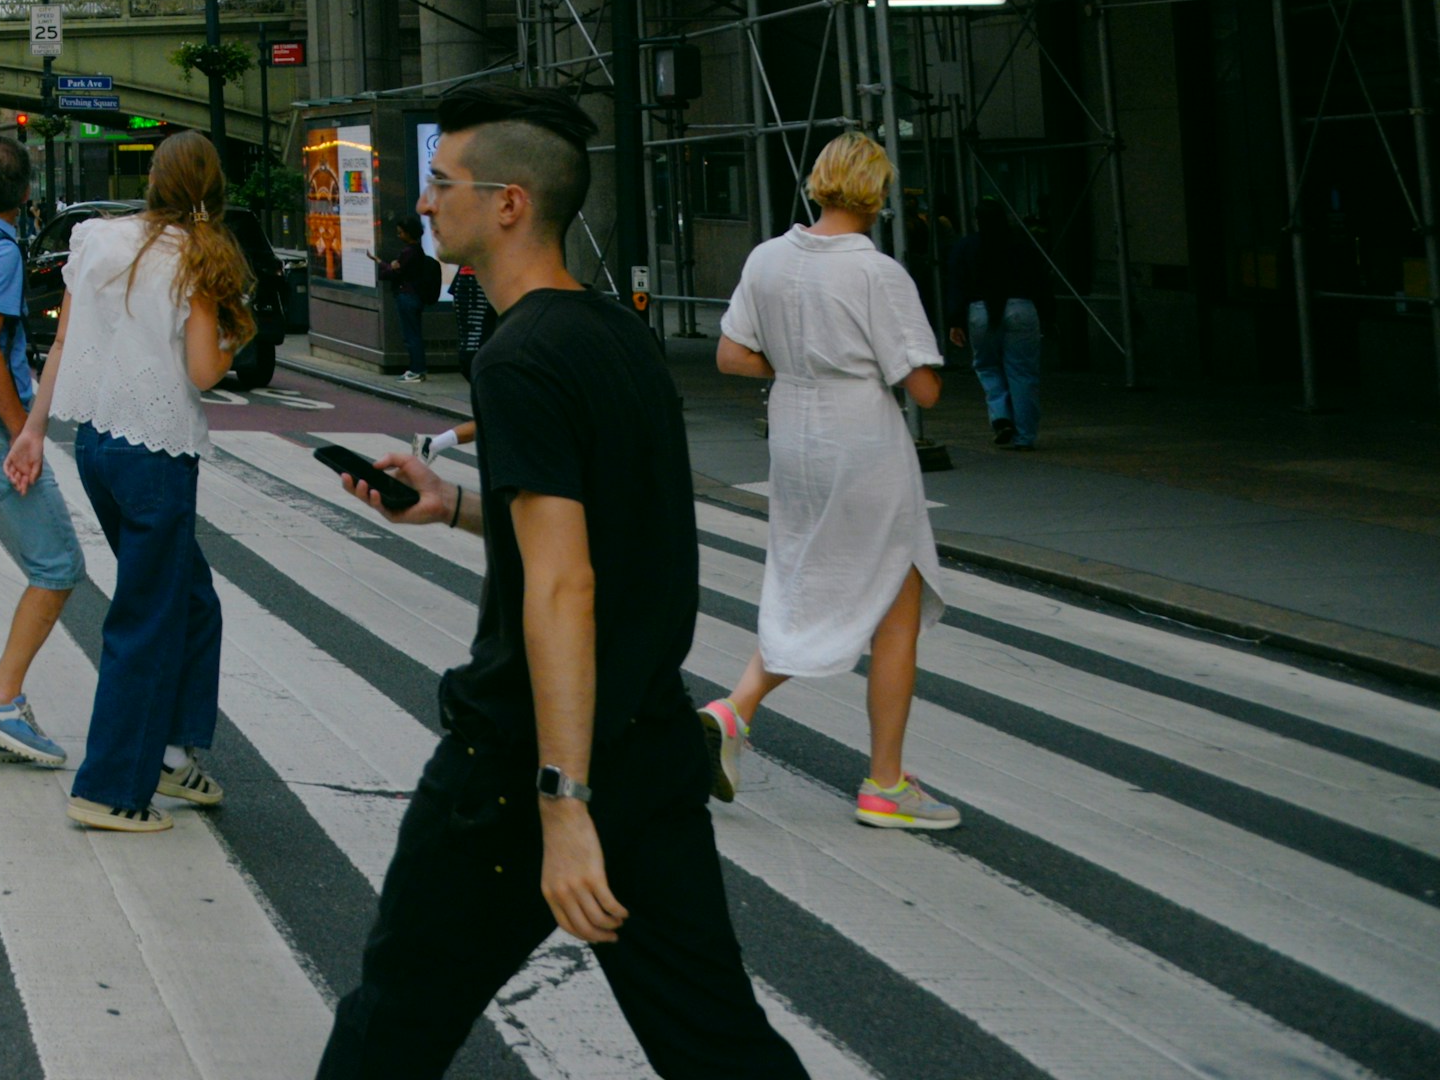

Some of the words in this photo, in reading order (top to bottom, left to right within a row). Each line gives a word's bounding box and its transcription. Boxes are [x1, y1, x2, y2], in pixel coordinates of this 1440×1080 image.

[35, 26, 58, 40] 25
[67, 79, 85, 88] Park
[87, 79, 102, 88] Ave
[61, 99, 92, 110] Pershing
[93, 100, 118, 108] Square
